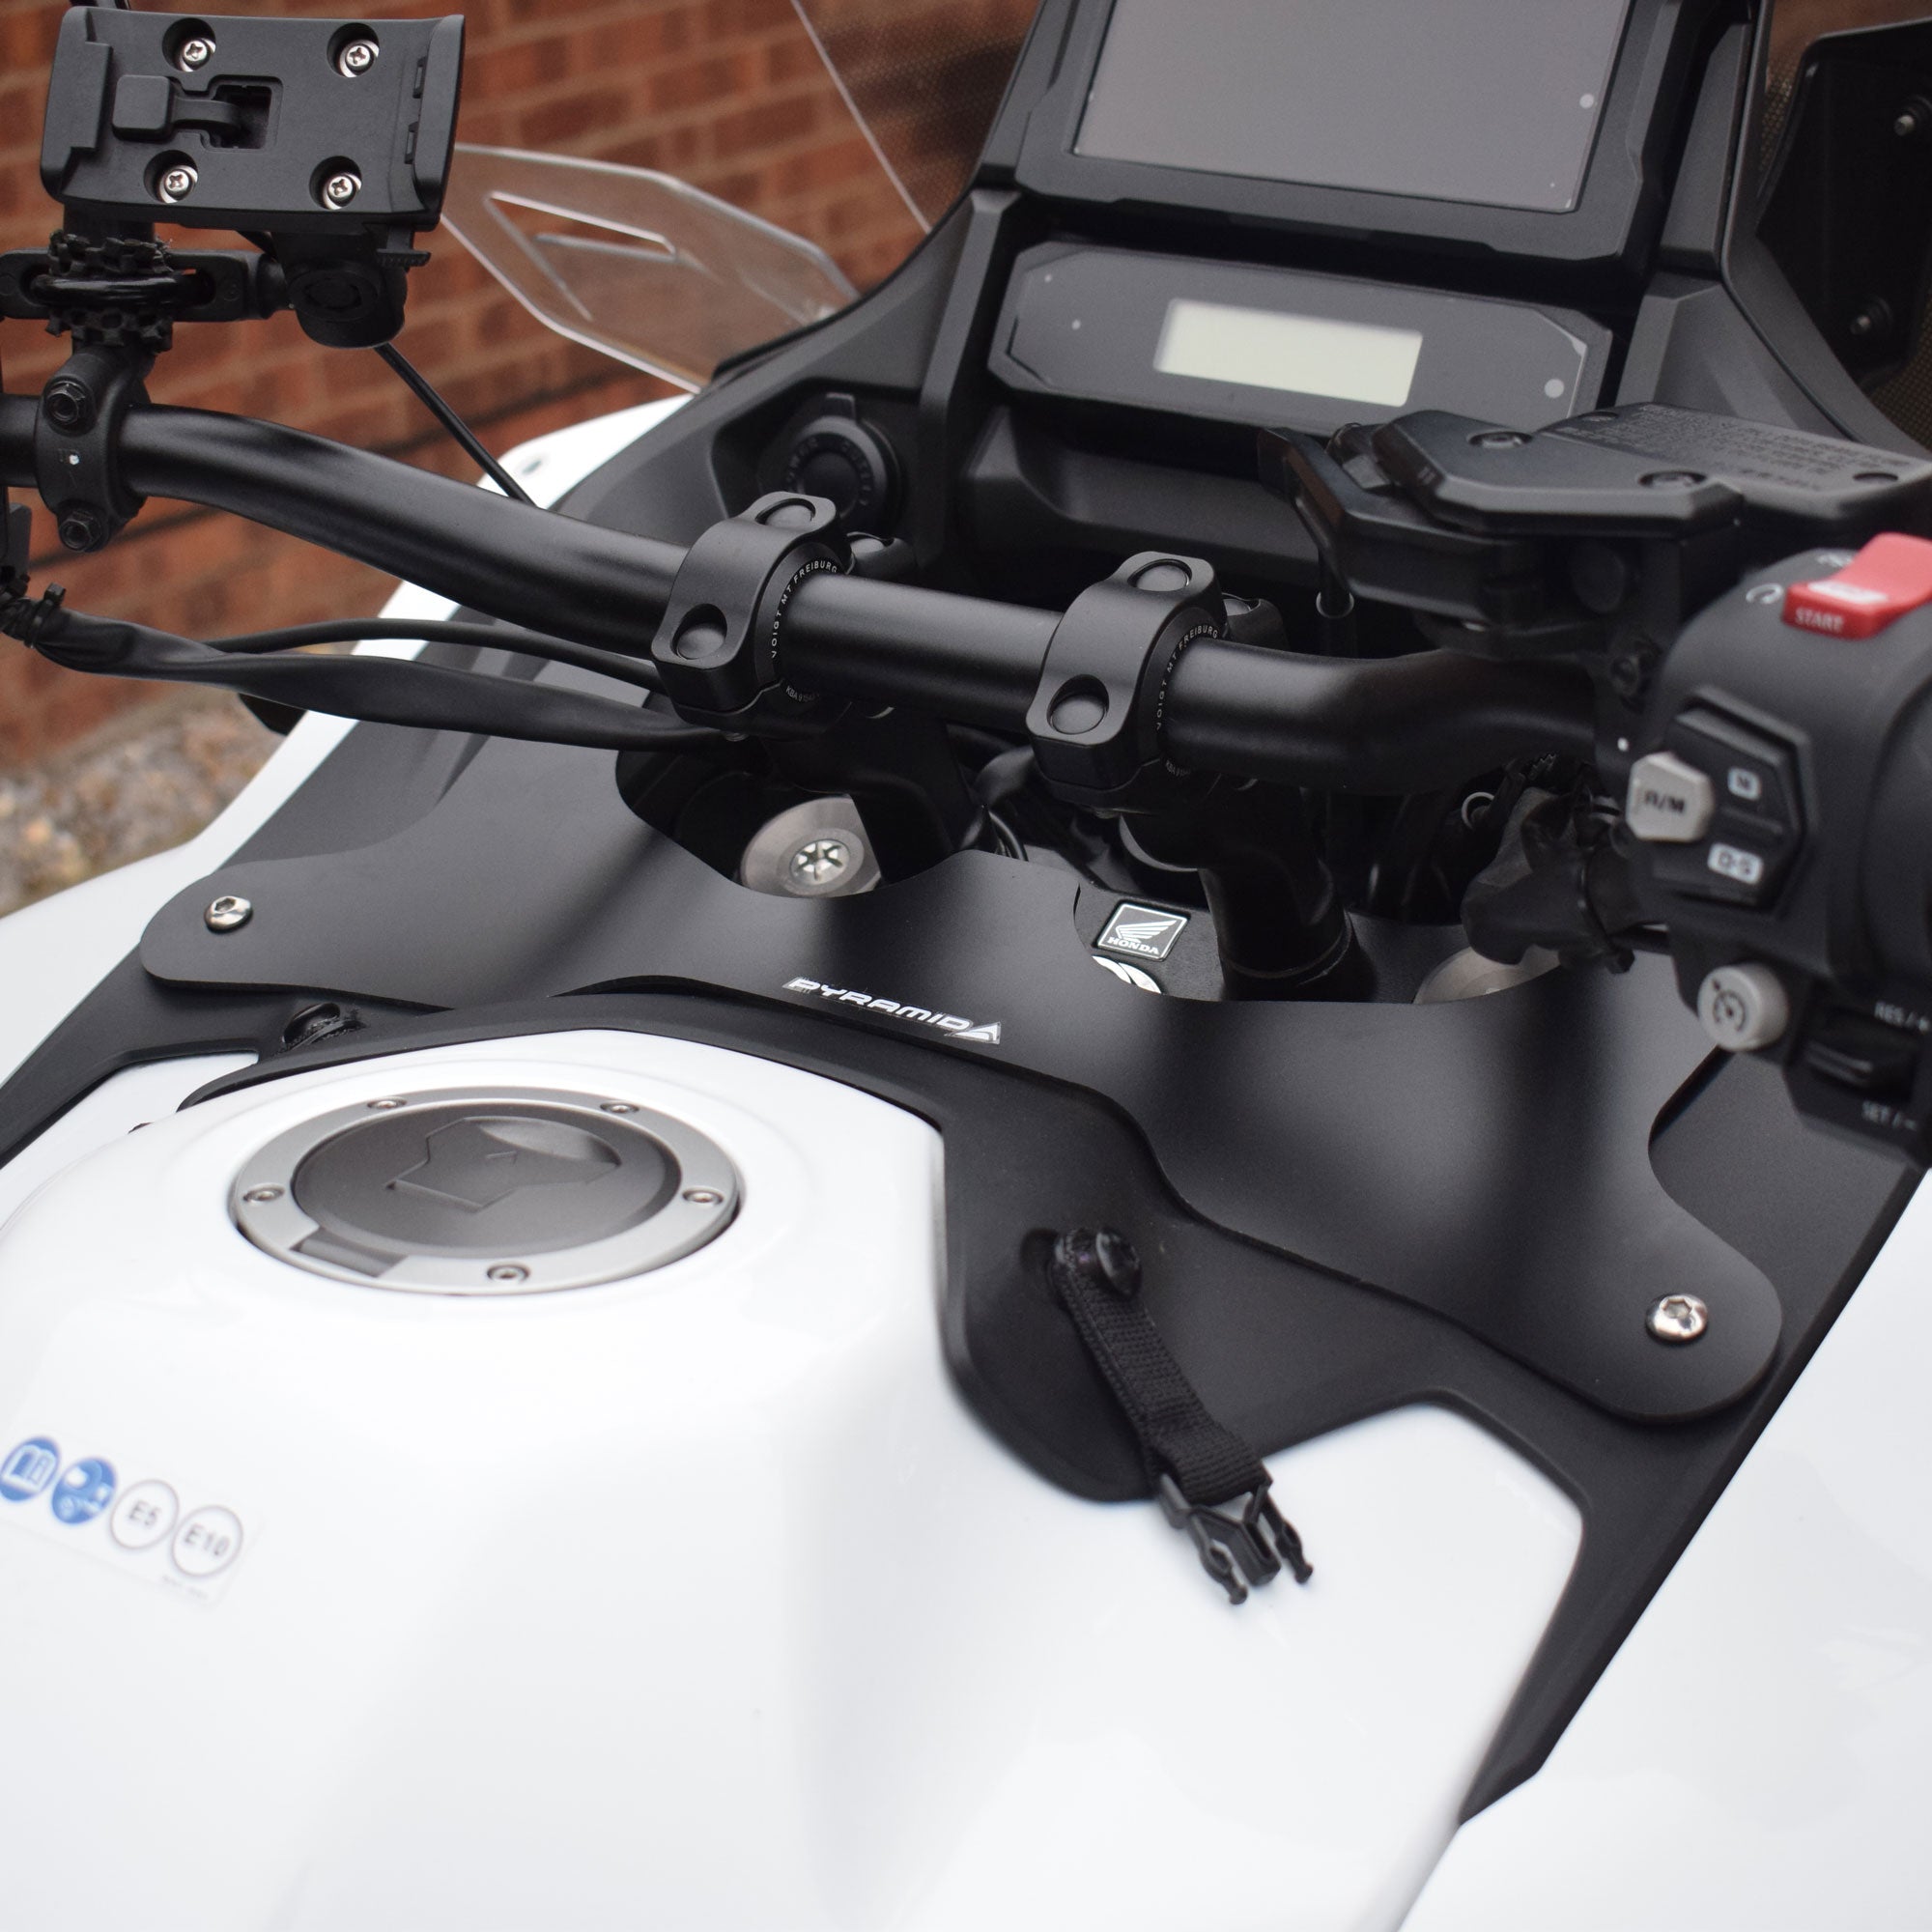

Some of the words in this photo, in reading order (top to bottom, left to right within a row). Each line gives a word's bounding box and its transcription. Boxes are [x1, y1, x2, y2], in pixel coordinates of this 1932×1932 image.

[771, 611, 781, 659] VOIGT
[781, 584, 793, 605] MT
[793, 560, 838, 584] FREIBURG
[1794, 607, 1844, 634] START
[1155, 680, 1167, 730] VOIGT
[1167, 653, 1178, 673] MT
[1179, 625, 1218, 651] FREIBURG
[1107, 936, 1160, 954] HONDA
[787, 978, 972, 1031] PYRAMID
[128, 1498, 162, 1529] E5
[184, 1522, 232, 1558] E10
